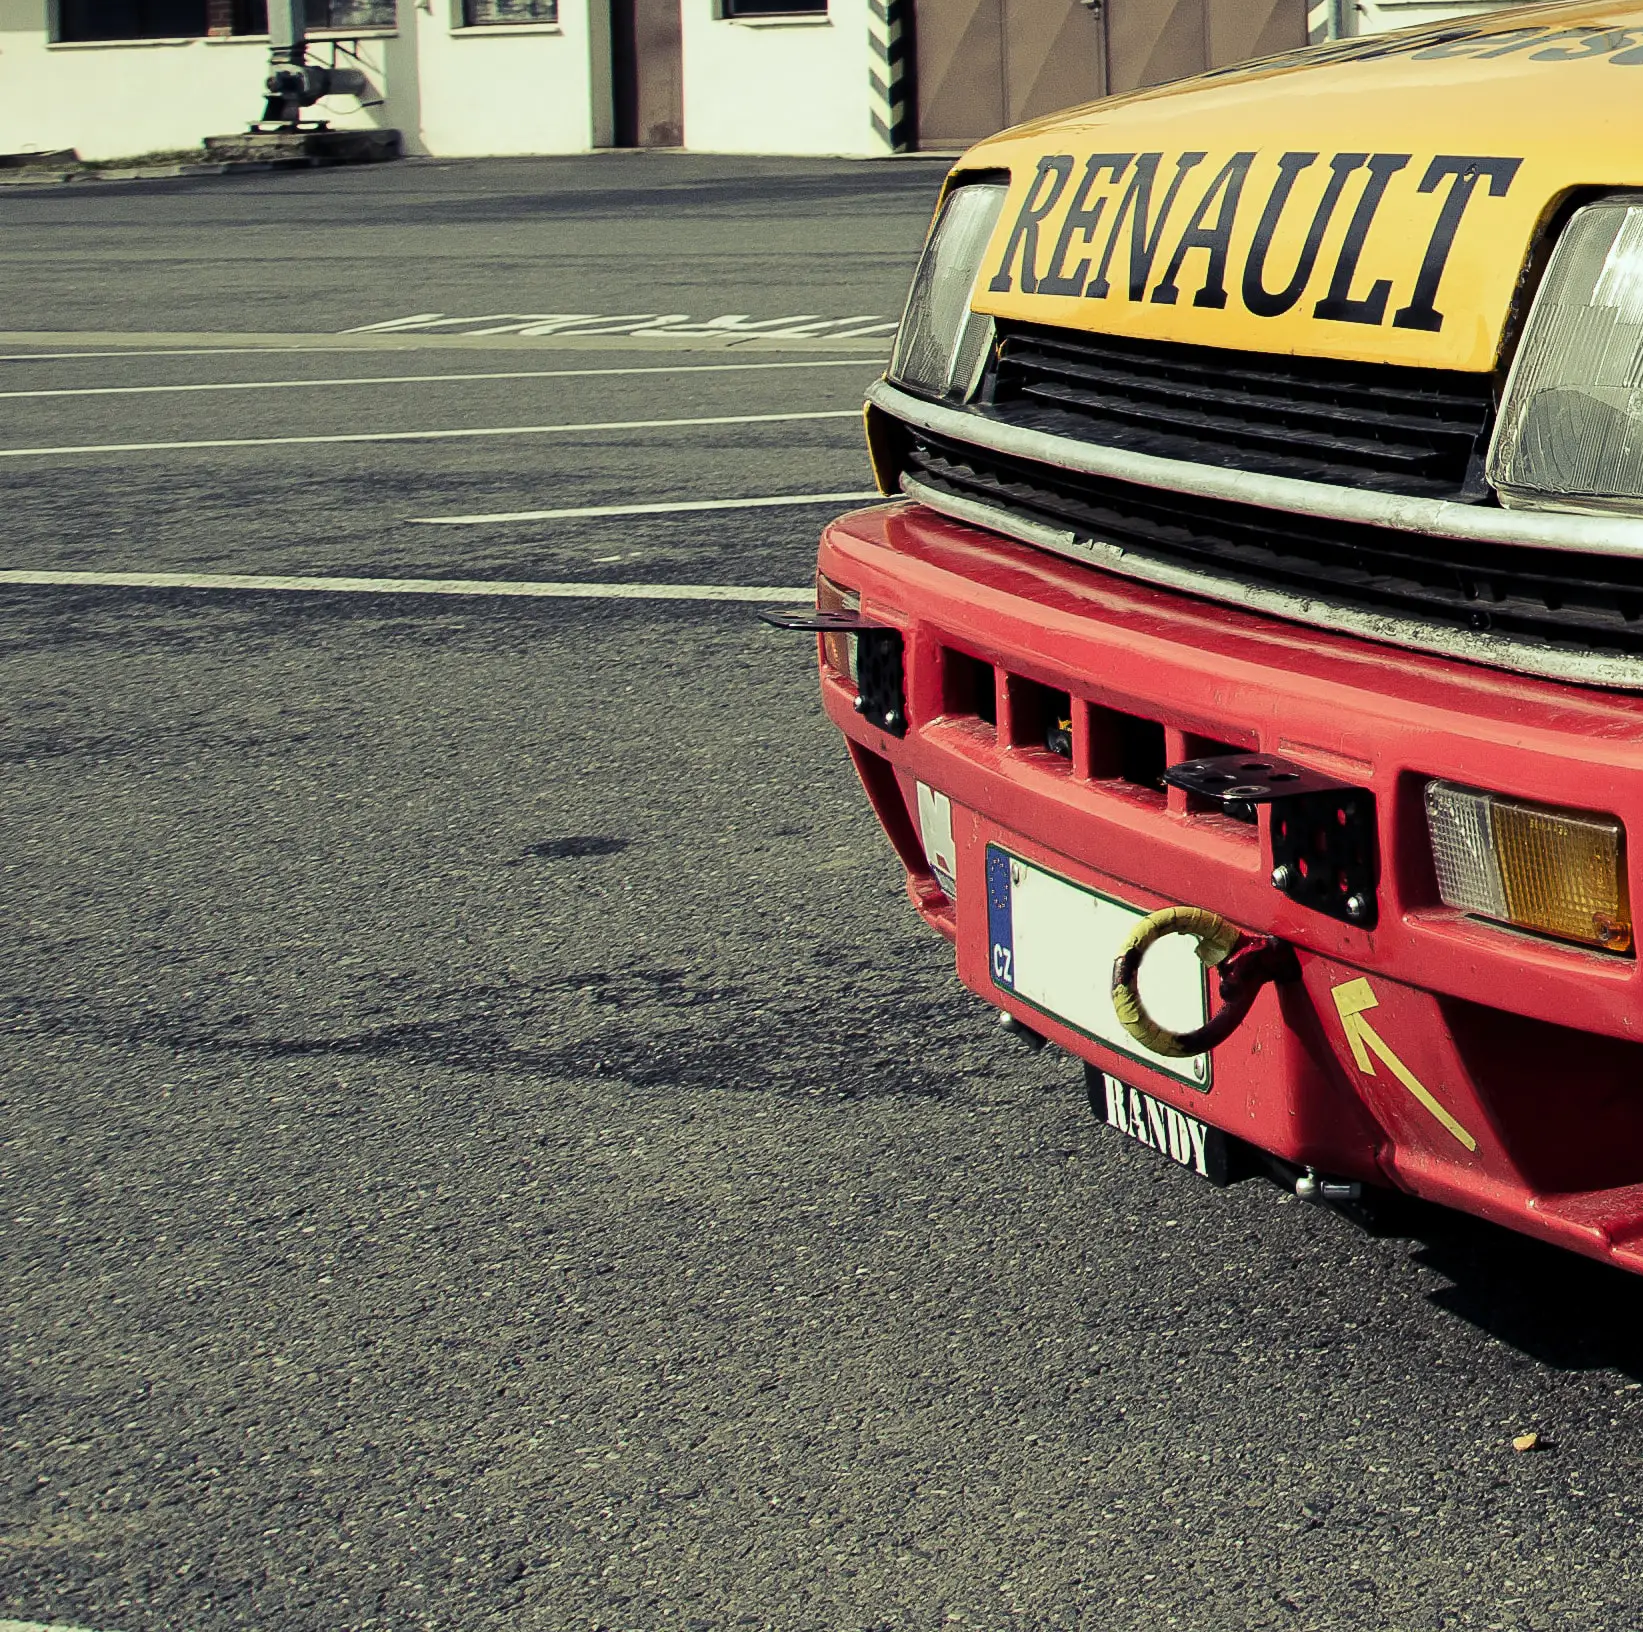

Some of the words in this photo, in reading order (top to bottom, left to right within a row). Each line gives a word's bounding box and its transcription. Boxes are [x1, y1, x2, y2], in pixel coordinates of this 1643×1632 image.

[990, 151, 1524, 333] RENAULT
[993, 942, 1012, 983] CZ
[1101, 1072, 1210, 1178] RANDY
